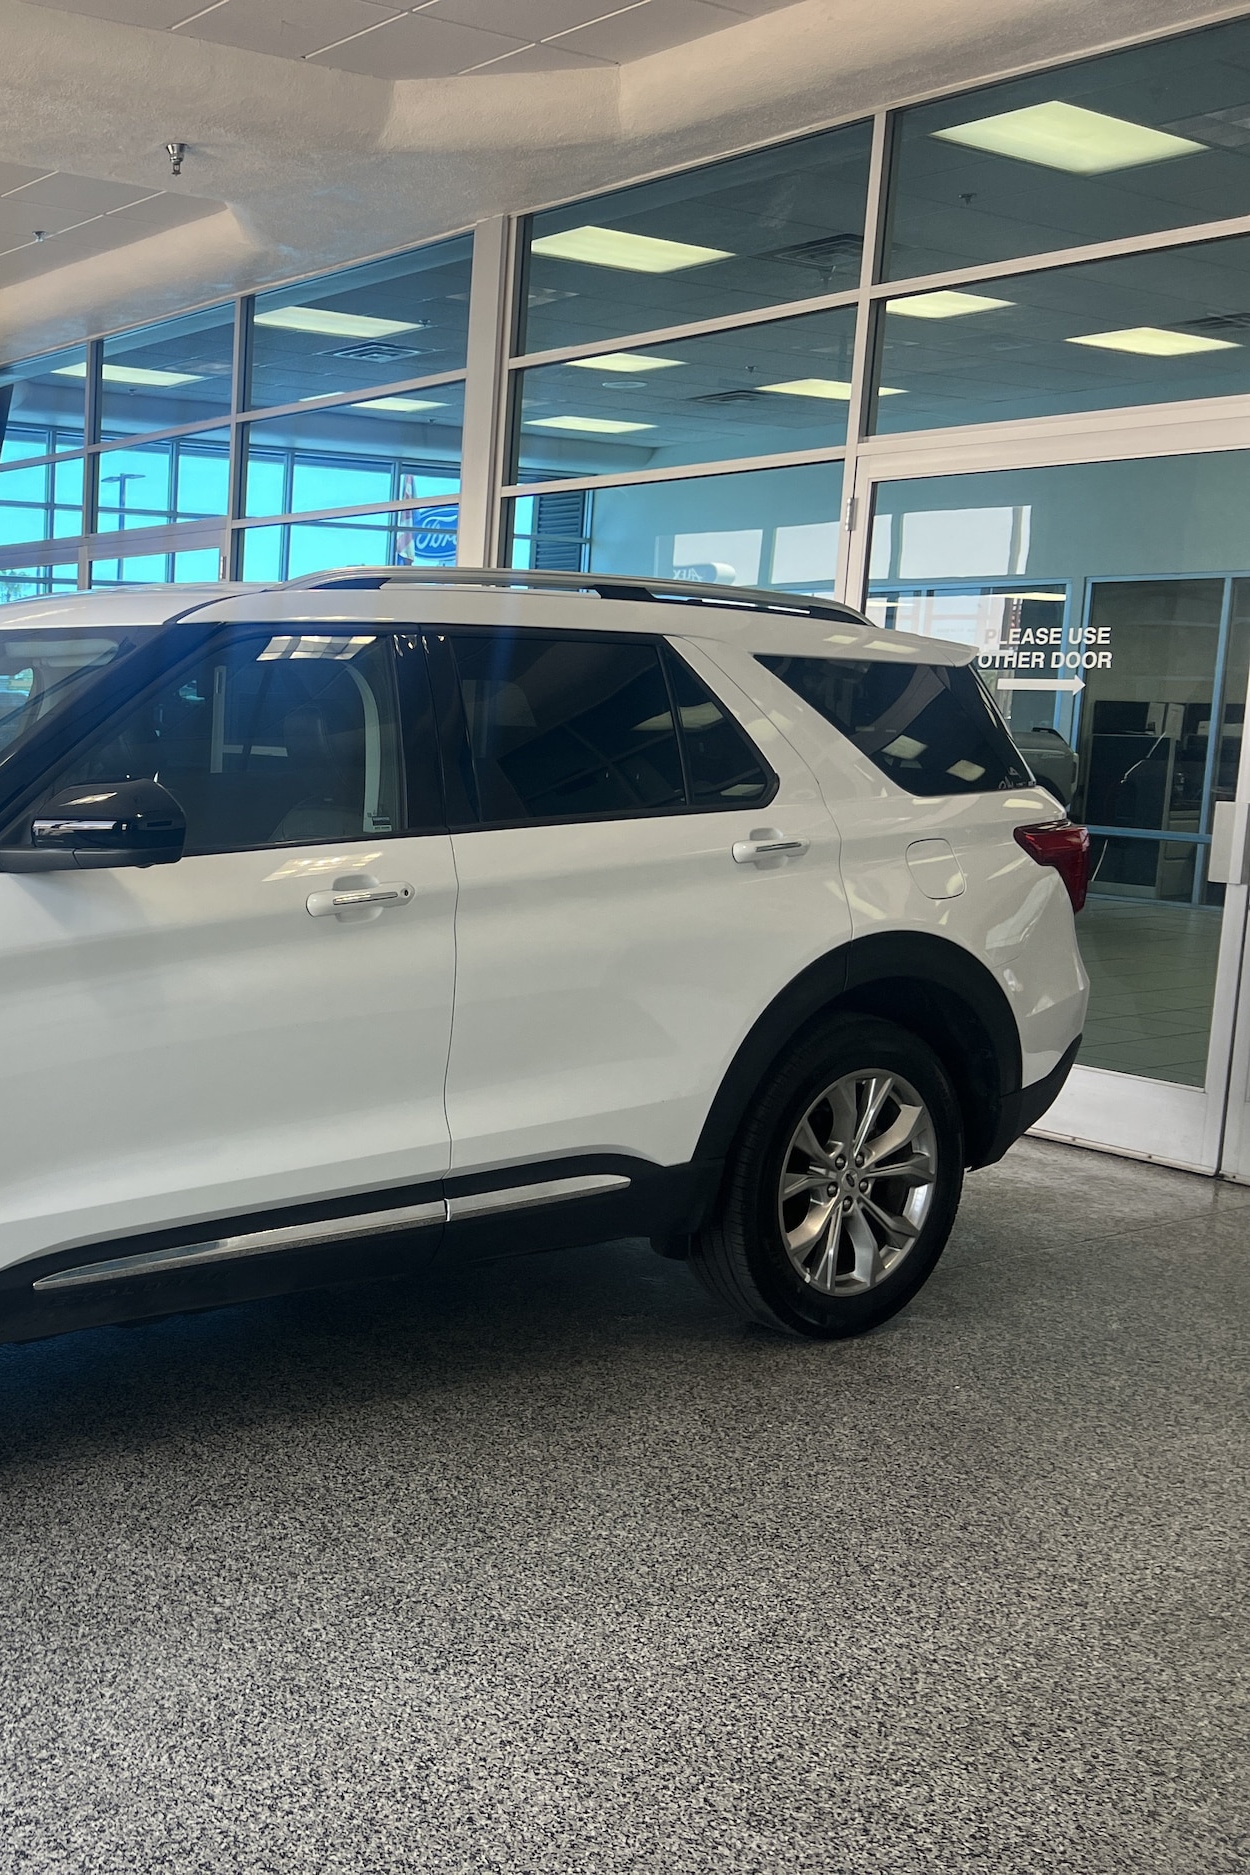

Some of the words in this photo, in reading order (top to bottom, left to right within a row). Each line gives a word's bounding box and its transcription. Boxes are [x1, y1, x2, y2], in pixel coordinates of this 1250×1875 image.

[415, 514, 458, 550] For
[1068, 627, 1112, 645] USE
[977, 651, 1046, 669] OTHER
[1050, 651, 1113, 669] DOOR
